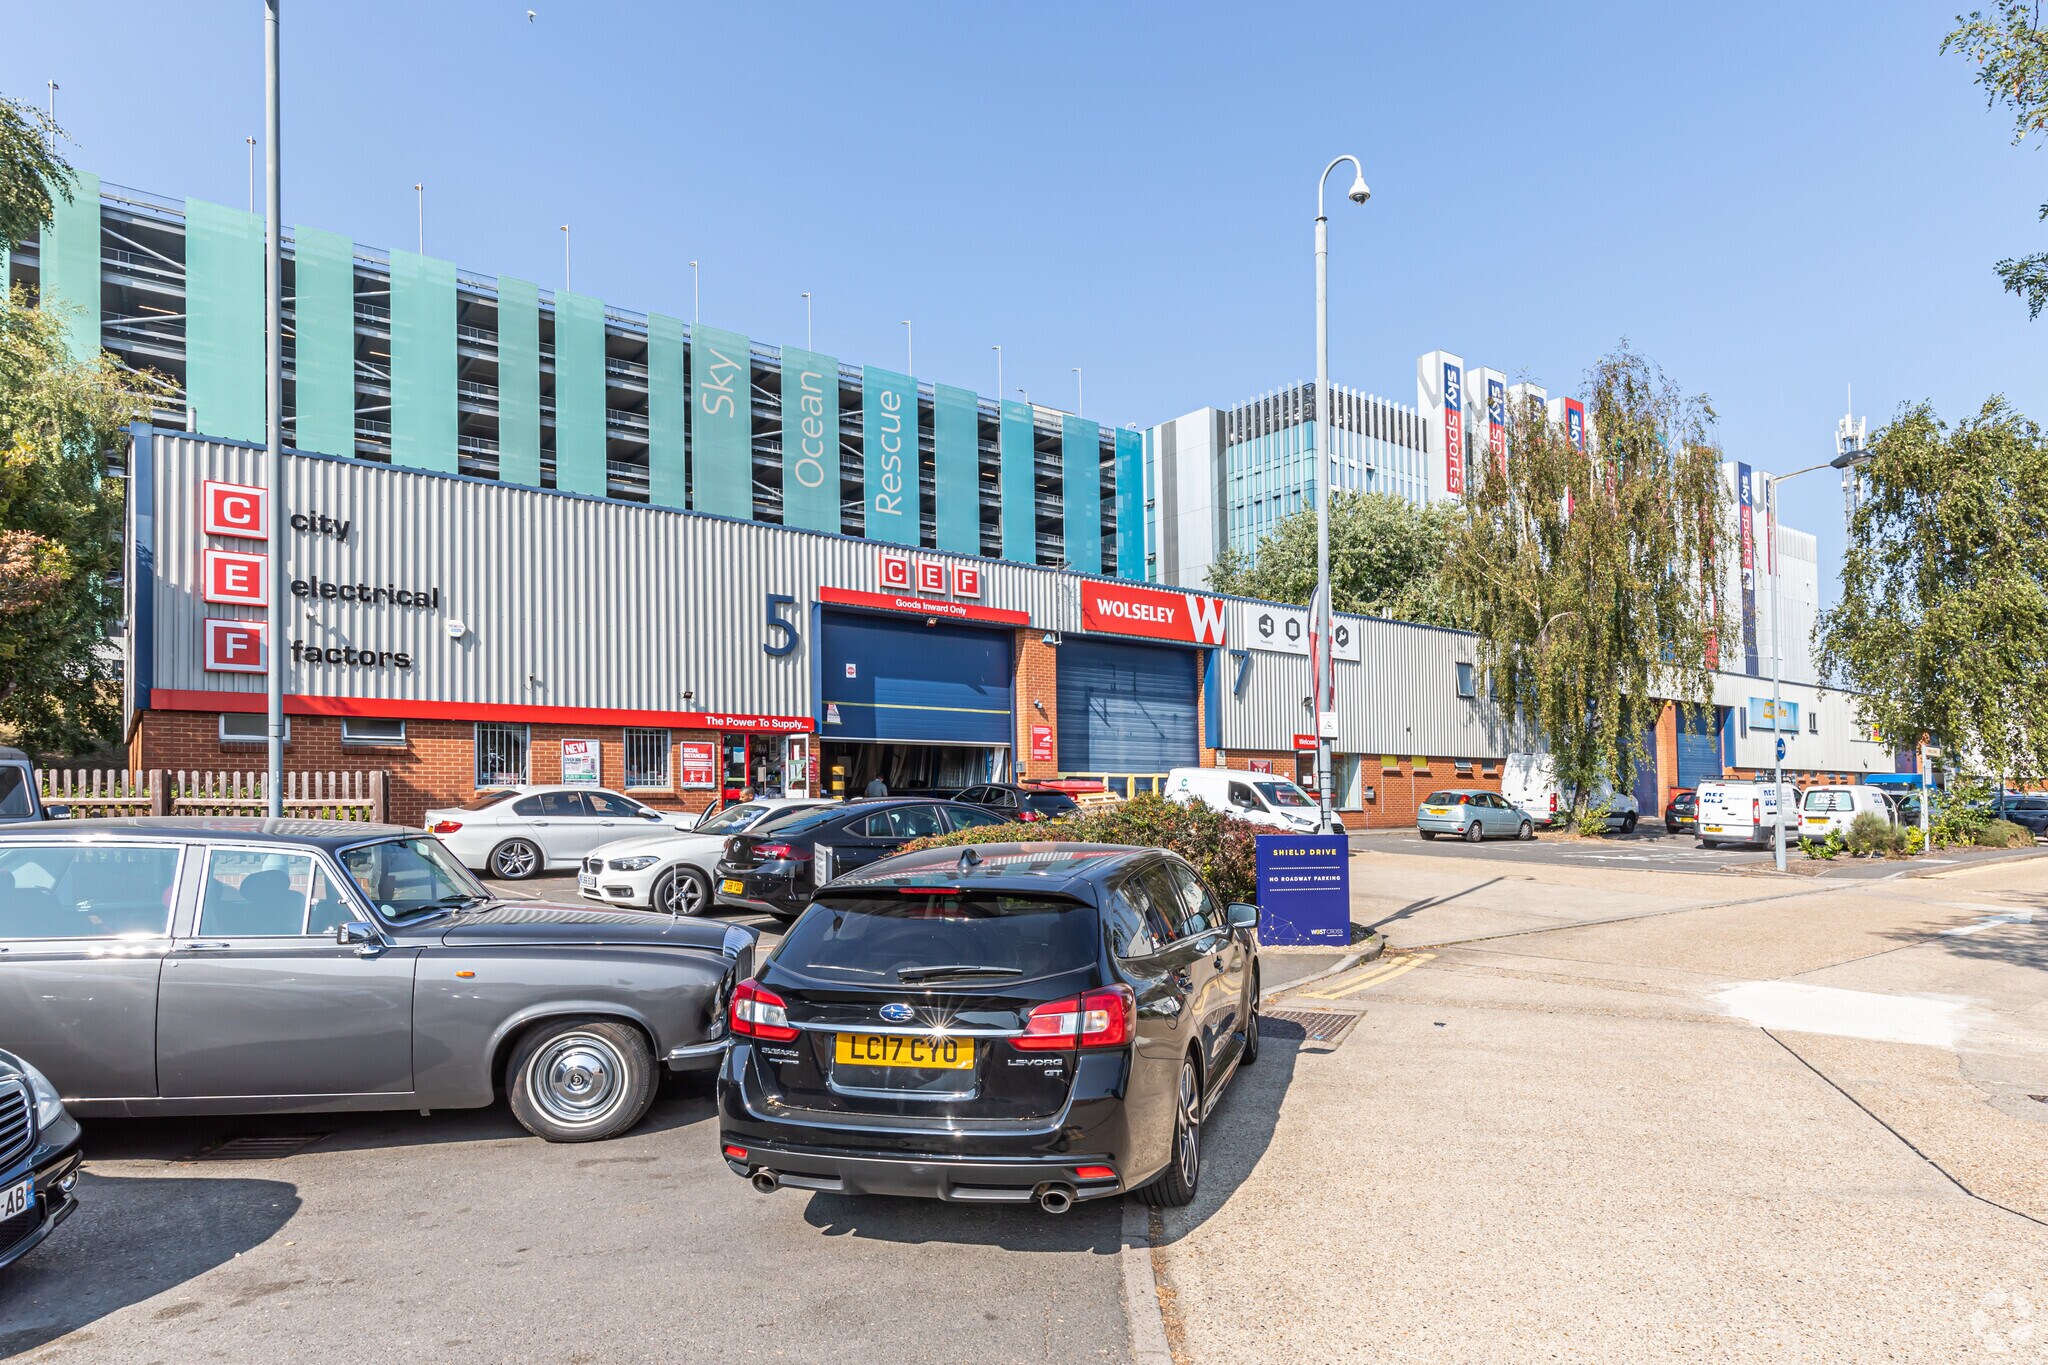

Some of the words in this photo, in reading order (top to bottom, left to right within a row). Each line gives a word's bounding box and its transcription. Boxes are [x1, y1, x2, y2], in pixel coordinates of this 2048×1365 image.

[701, 347, 742, 418] Sky
[1445, 368, 1461, 408] sky
[1489, 384, 1504, 422] sky
[794, 371, 824, 488] Ocean
[875, 390, 902, 516] Rescue
[1446, 413, 1461, 489] sports
[1741, 475, 1751, 504] sky
[223, 496, 251, 524] C
[290, 510, 351, 542] city
[1742, 508, 1753, 566] sports
[225, 563, 249, 592] E
[290, 575, 439, 609] electrical
[895, 598, 921, 611] Goods
[923, 601, 949, 613] Inward
[950, 603, 967, 616] Only
[1096, 598, 1175, 624] WOLSELEY
[1185, 594, 1226, 645] W
[763, 593, 799, 656] 5
[226, 632, 248, 659] F
[290, 639, 412, 668] factors
[1230, 650, 1250, 695] 7
[705, 716, 724, 726] The
[726, 717, 756, 727] Power
[758, 718, 770, 727] To
[772, 719, 809, 730] Supply...
[565, 742, 585, 755] NEW
[1298, 738, 1316, 746] Welcom
[1309, 848, 1337, 856] DRIVE
[851, 1035, 903, 1061] LC17
[911, 1038, 957, 1063] CYO
[1007, 1058, 1063, 1066] LEVORG
[1044, 1069, 1063, 1077] GT
